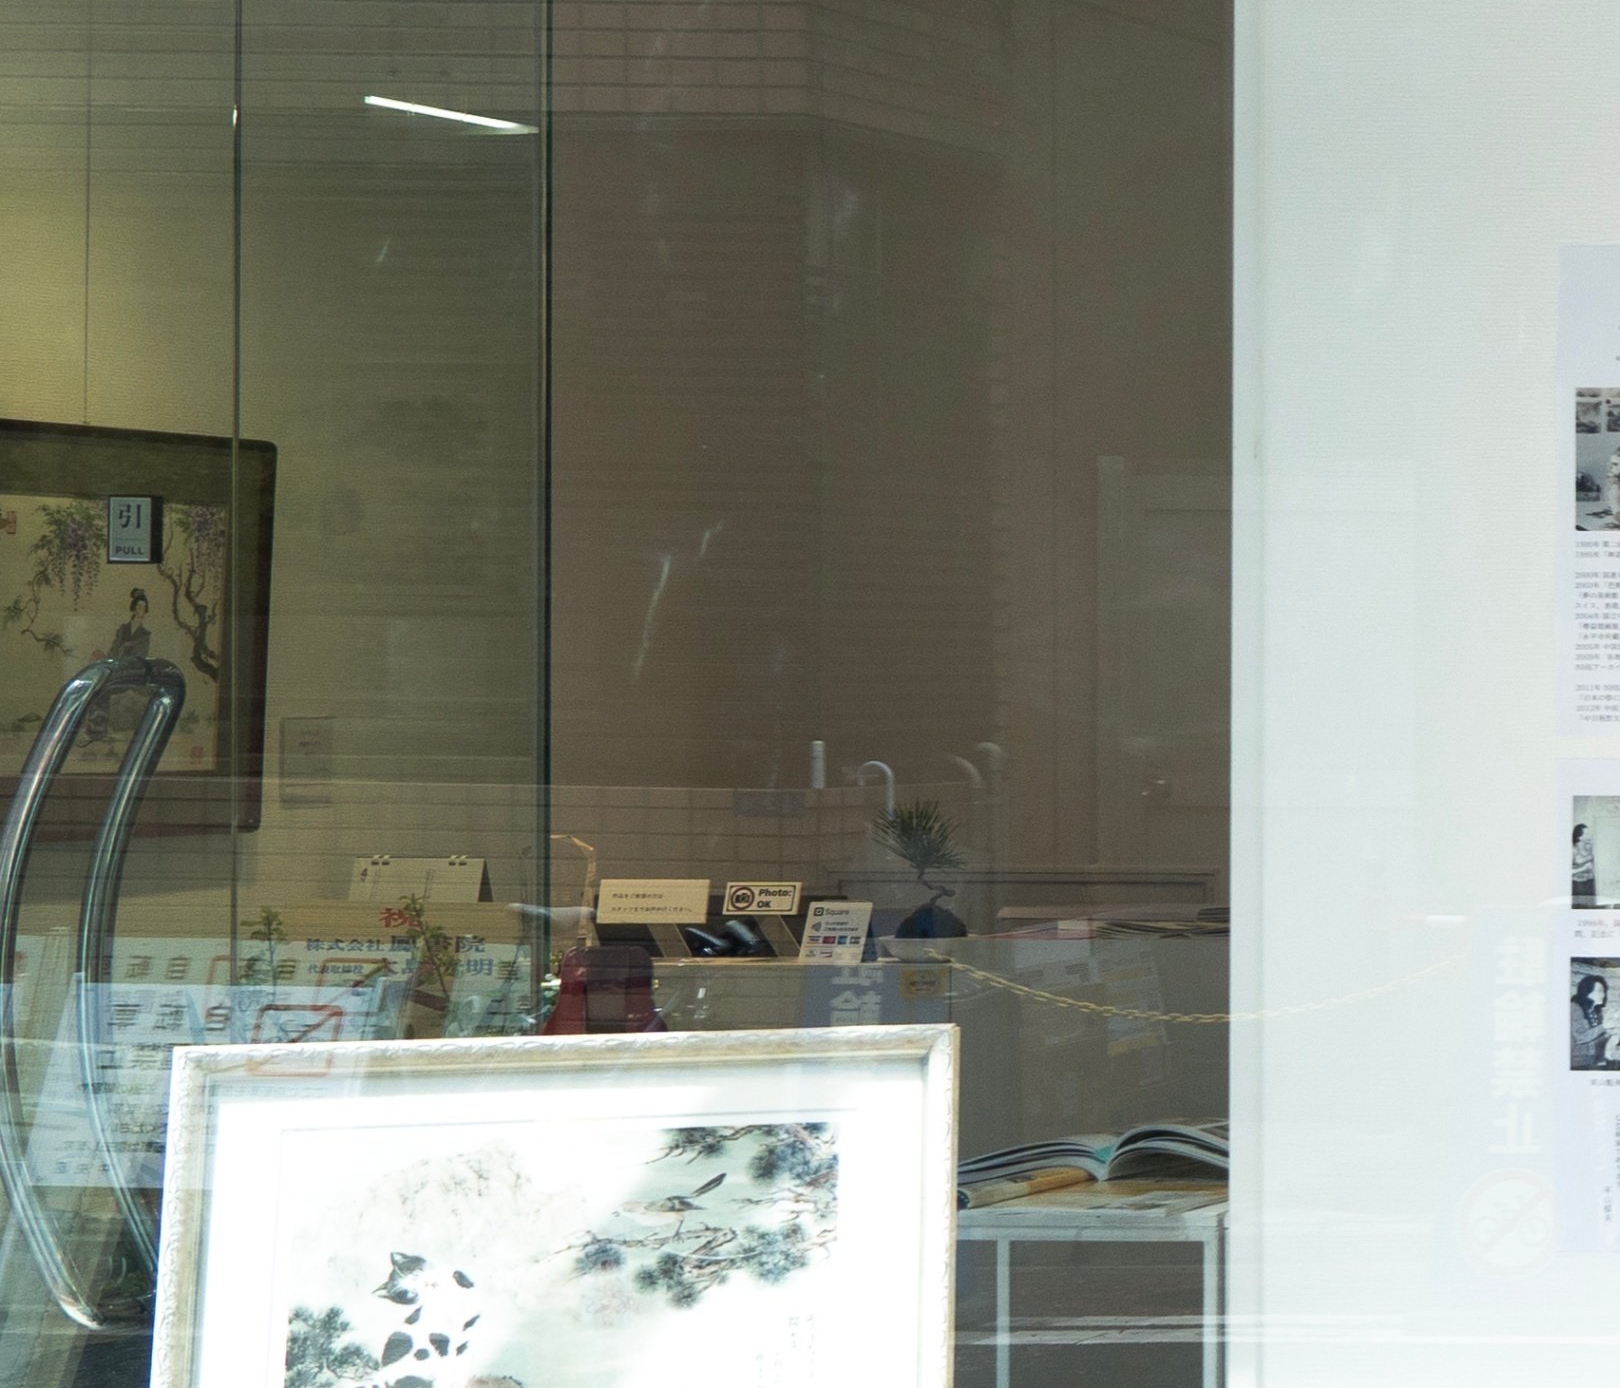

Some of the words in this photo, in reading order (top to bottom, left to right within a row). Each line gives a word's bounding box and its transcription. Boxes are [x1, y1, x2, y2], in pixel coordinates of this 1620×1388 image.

[118, 503, 142, 529] 引
[115, 545, 144, 555] PULL
[758, 887, 792, 899] Photo:
[756, 900, 772, 909] OK
[824, 907, 850, 917] Square
